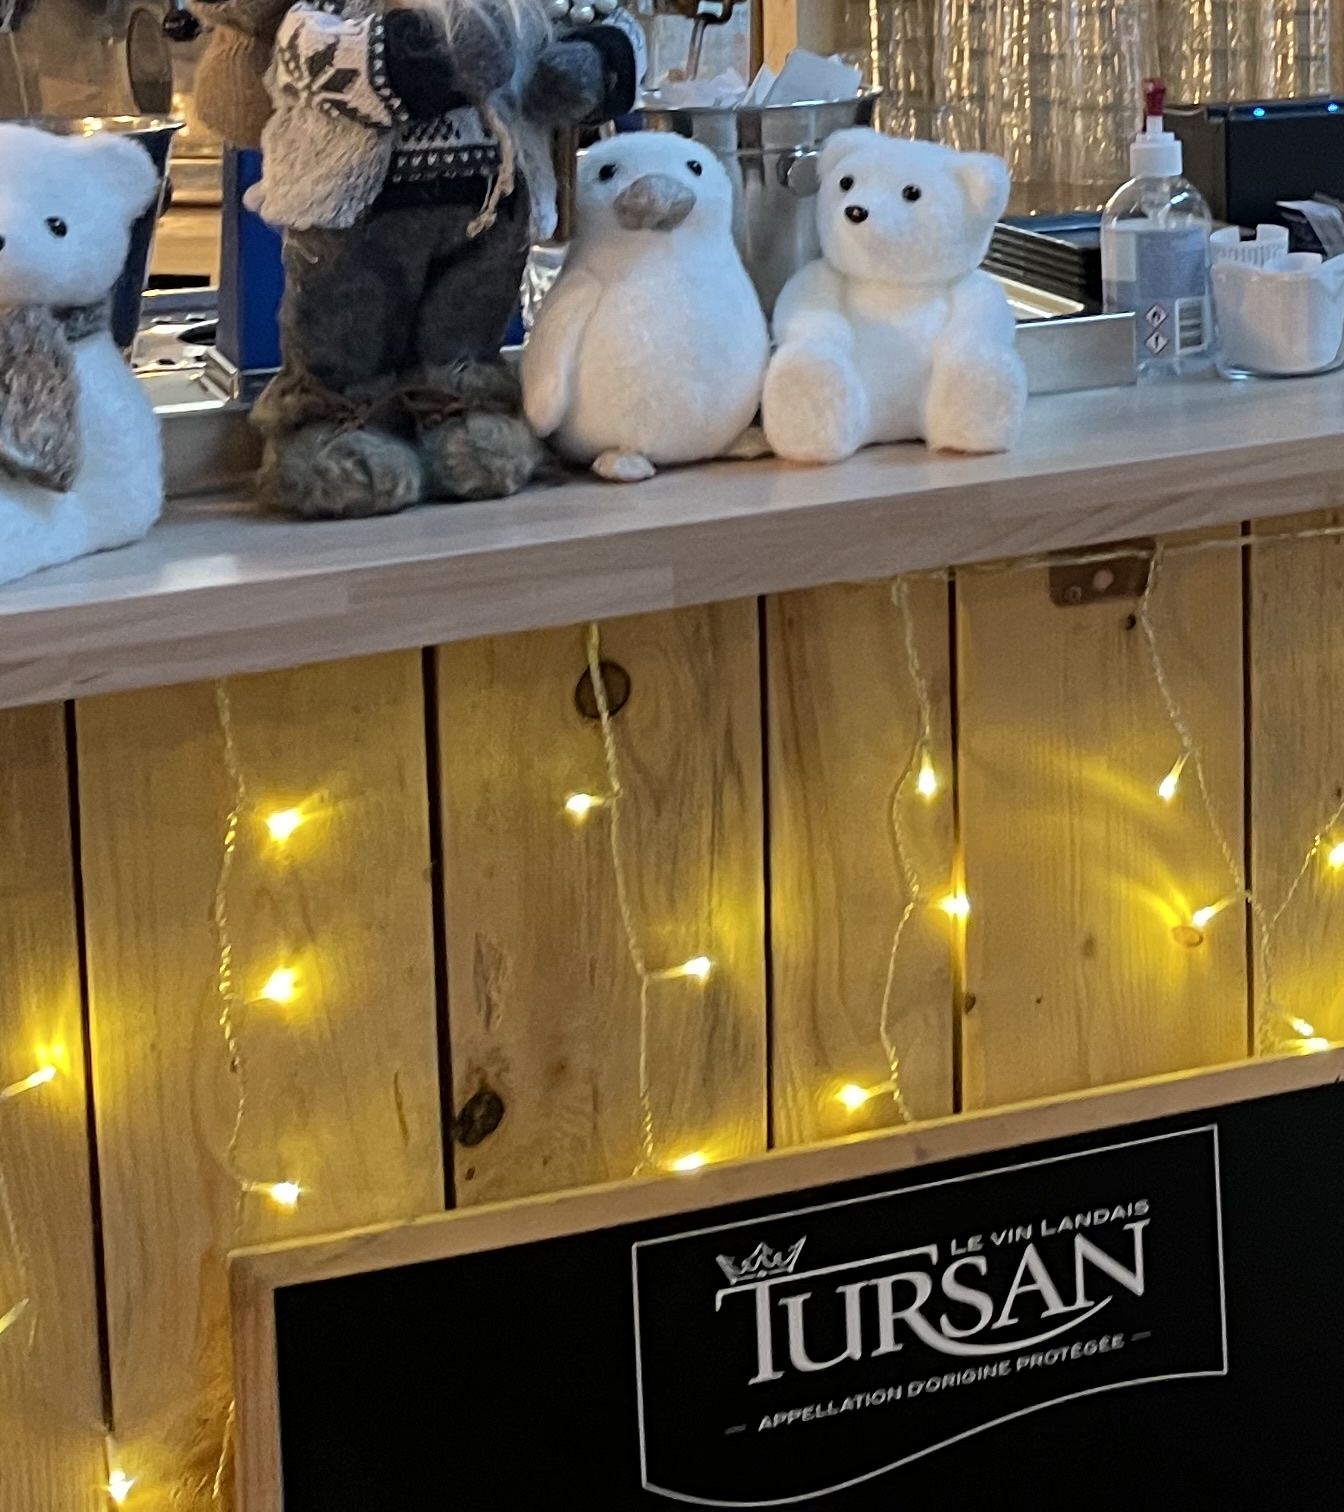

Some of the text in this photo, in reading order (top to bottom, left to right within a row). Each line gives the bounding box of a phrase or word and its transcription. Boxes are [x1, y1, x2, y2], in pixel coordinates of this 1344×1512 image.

[950, 1198, 1151, 1257] LE VIN LANDAIS
[714, 1218, 1151, 1387] TURSAN
[757, 1331, 1126, 1434] APPELLATION D'ORIGINE PROTÉGÉE
